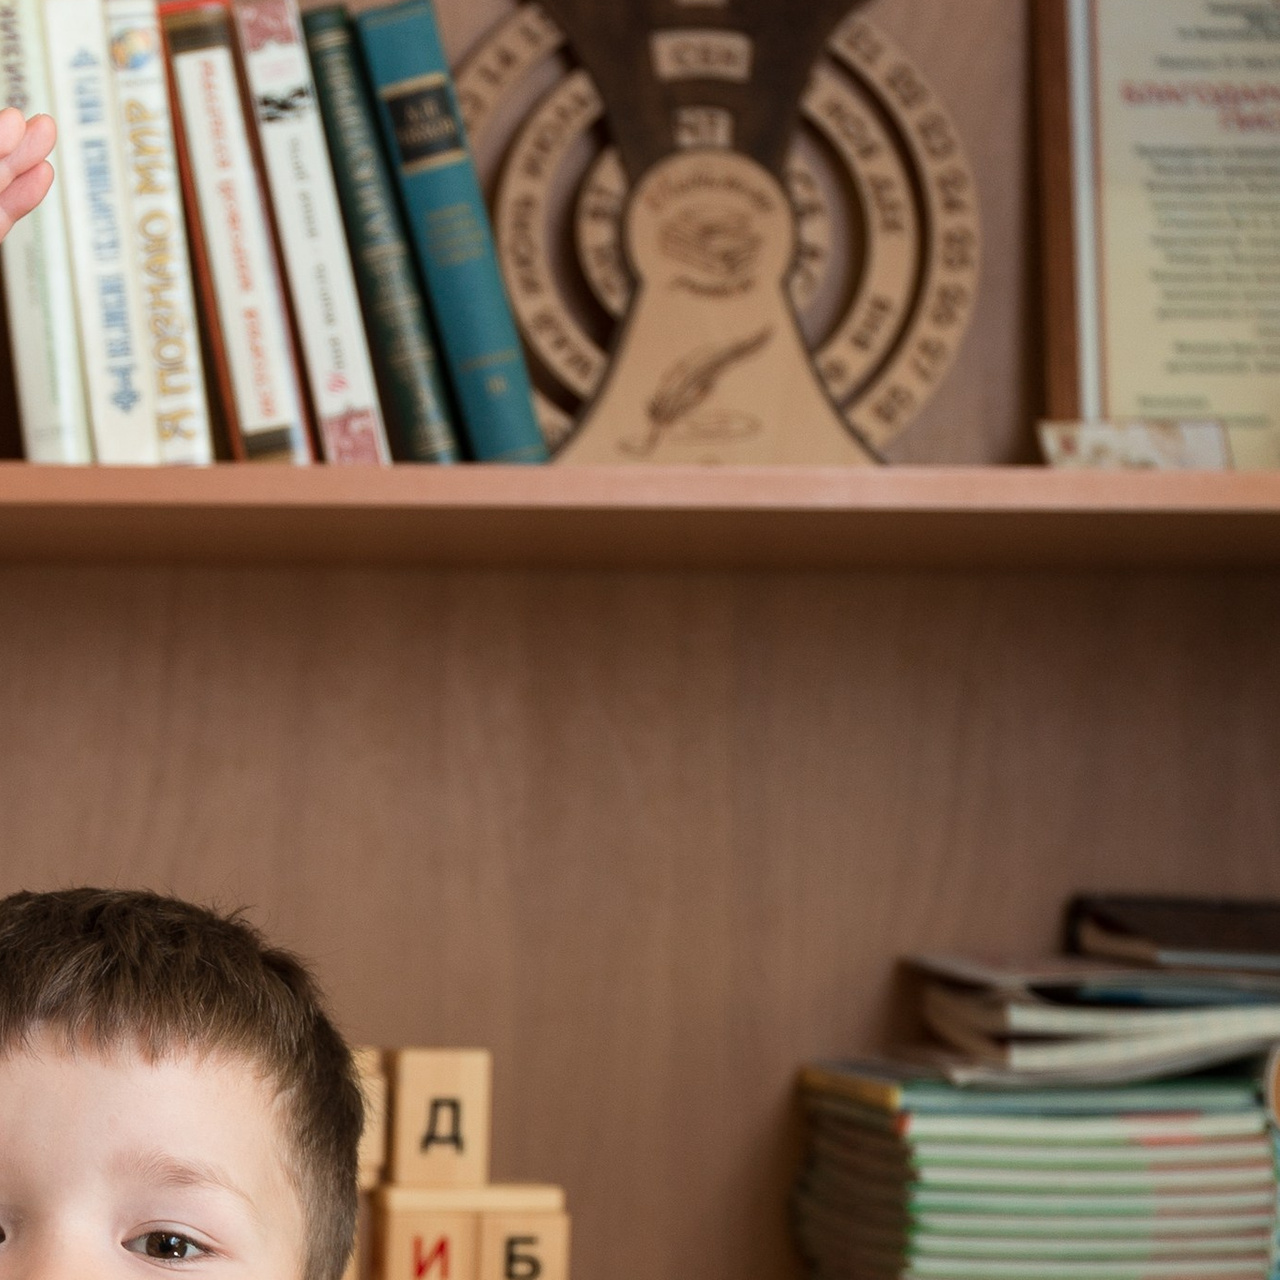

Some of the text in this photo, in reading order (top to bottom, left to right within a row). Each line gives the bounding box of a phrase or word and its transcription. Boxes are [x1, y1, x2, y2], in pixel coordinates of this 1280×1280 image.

[121, 98, 197, 442] Я ПОЗНАЮ МИР
[420, 1096, 465, 1154] Д
